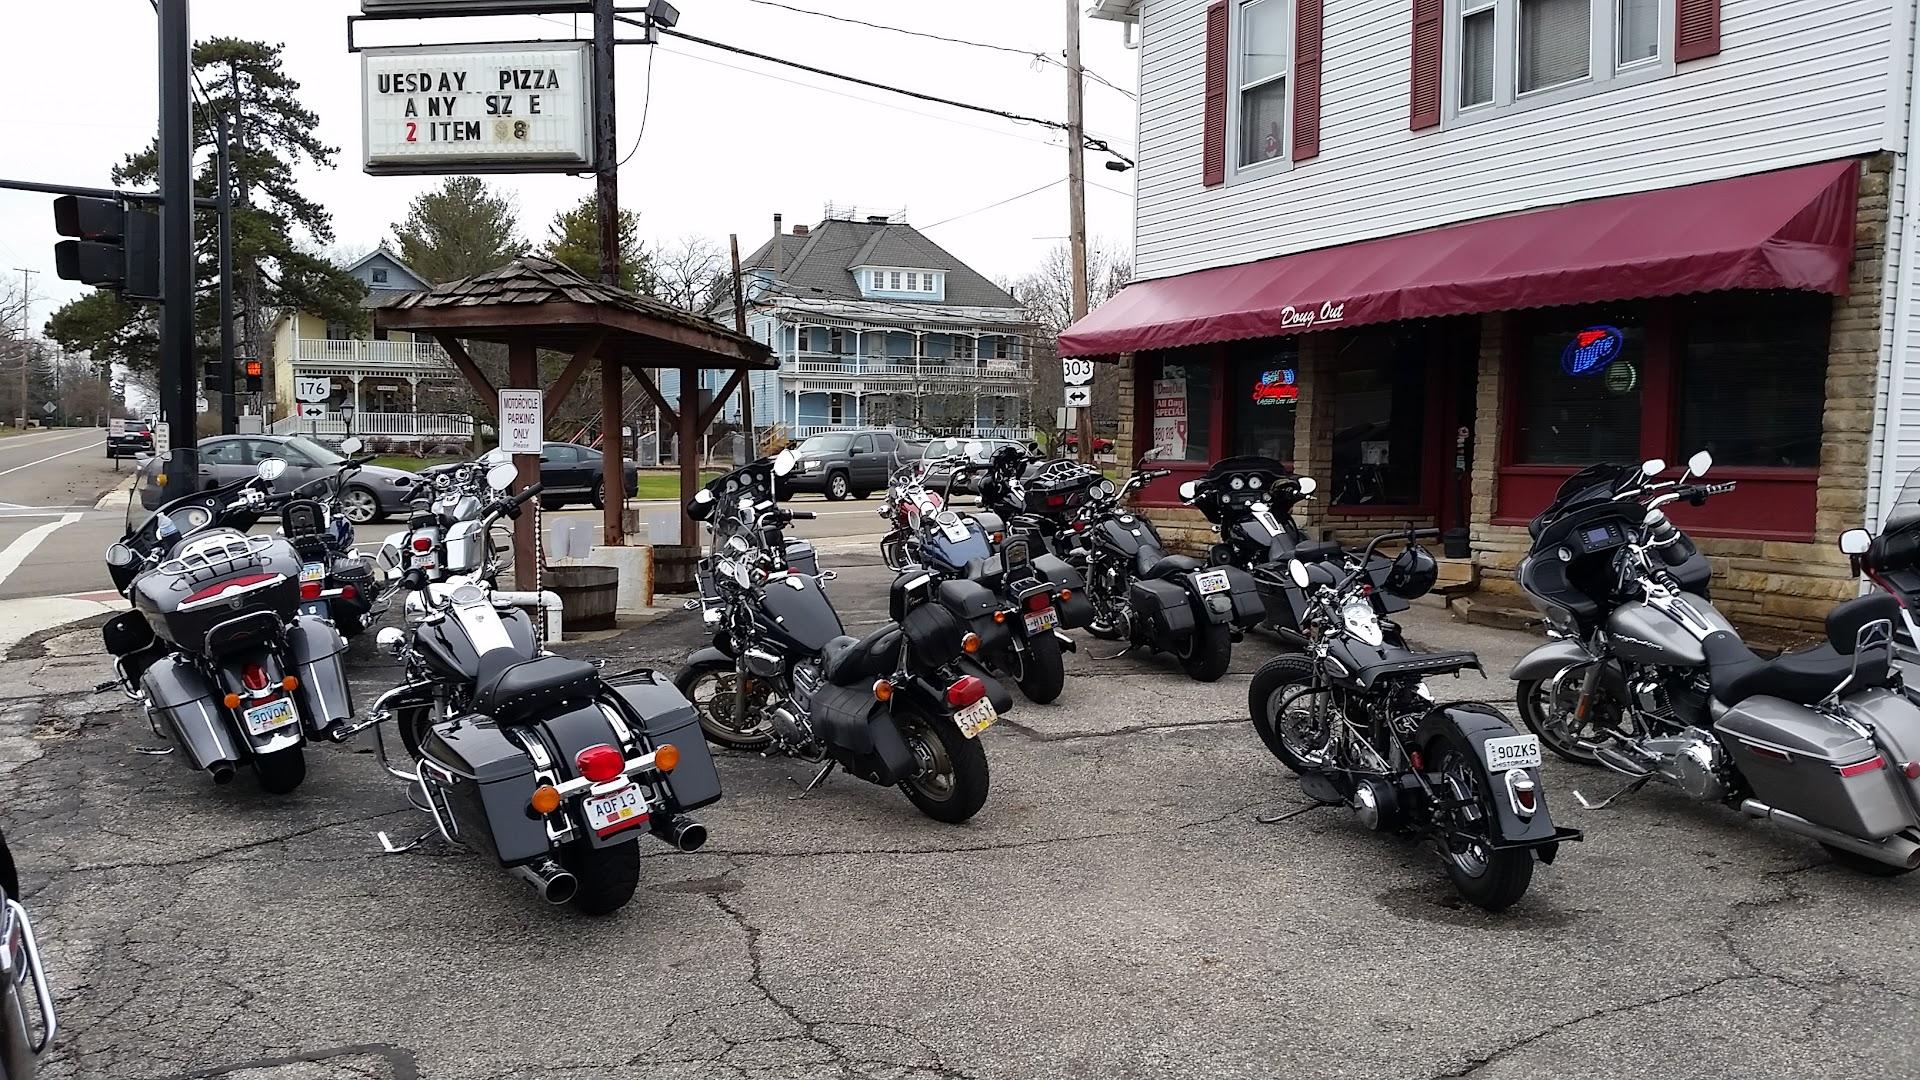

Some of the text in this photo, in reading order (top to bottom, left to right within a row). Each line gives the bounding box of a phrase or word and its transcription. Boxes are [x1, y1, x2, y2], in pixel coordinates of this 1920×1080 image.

[377, 69, 560, 94] UESDAY PIZZA
[406, 122, 418, 142] 2
[430, 121, 481, 142] ITEM
[1281, 300, 1345, 328] Doug Out
[1064, 360, 1091, 377] 303
[300, 382, 325, 395] 176
[503, 397, 538, 409] MOTORCYCLE
[1157, 399, 1184, 408] All Day
[507, 413, 535, 424] PARKING
[1155, 407, 1185, 417] SPECIAL
[513, 428, 530, 440] ONLY
[960, 703, 993, 731] 53CSY
[1498, 743, 1537, 759] 90ZKS
[1496, 759, 1534, 768] HISTORICAL
